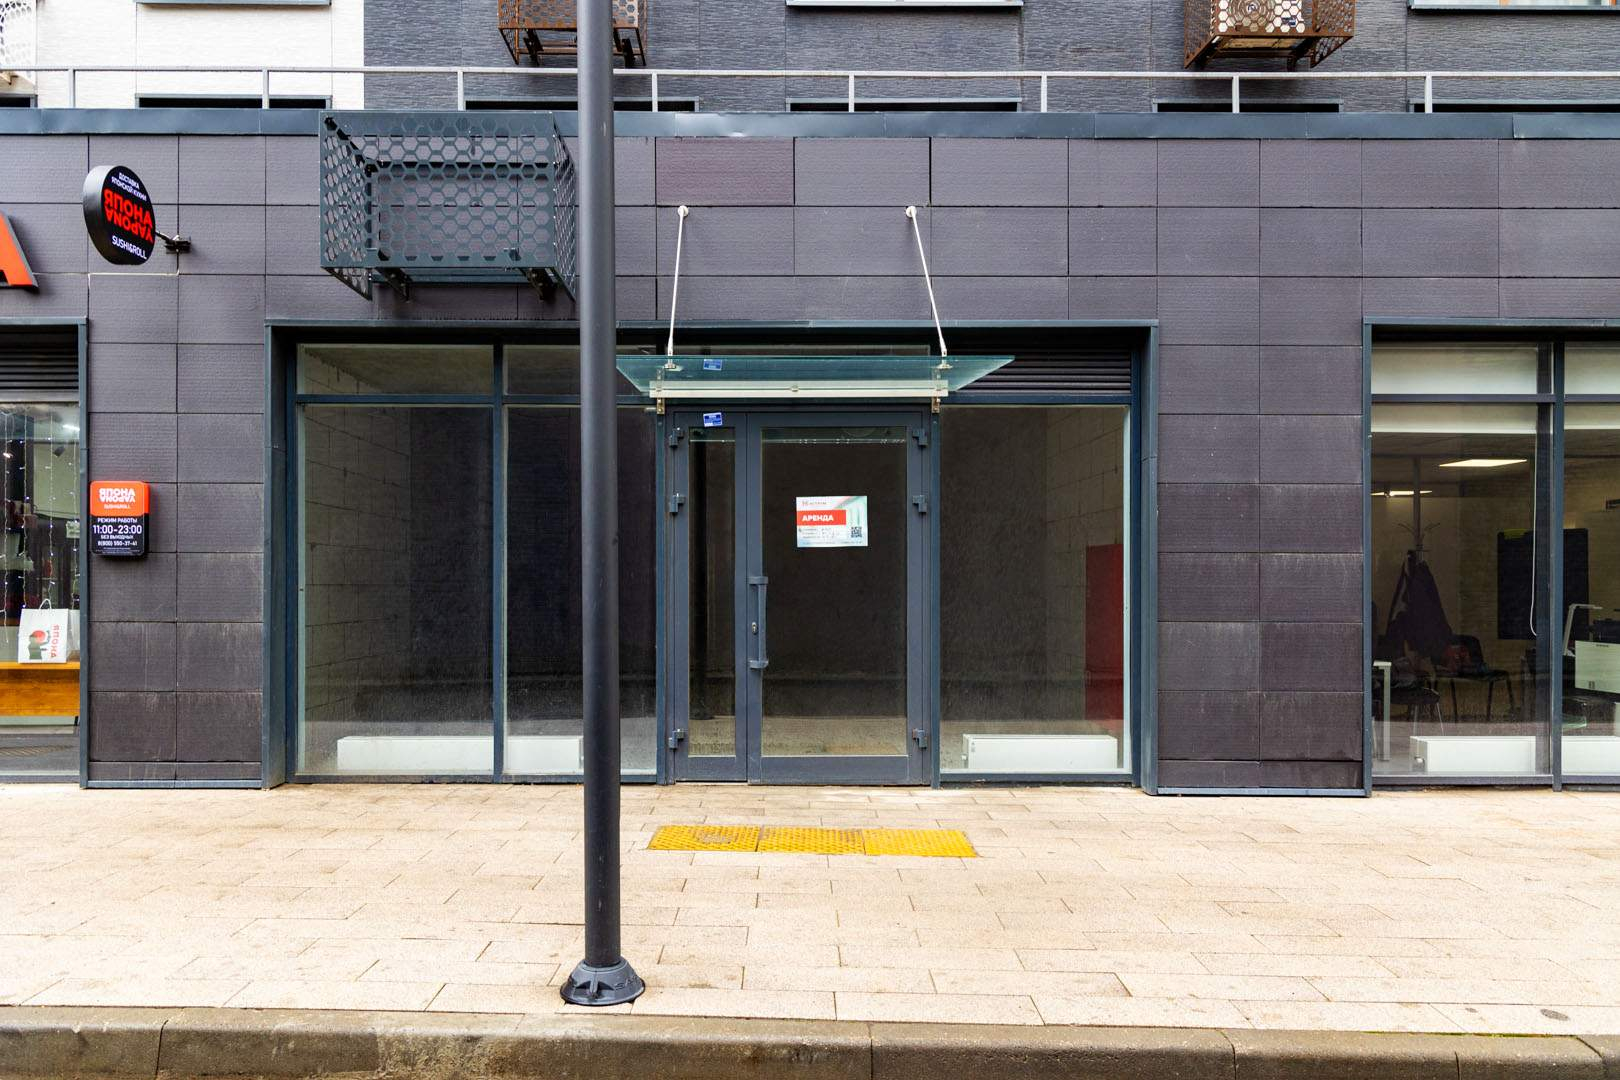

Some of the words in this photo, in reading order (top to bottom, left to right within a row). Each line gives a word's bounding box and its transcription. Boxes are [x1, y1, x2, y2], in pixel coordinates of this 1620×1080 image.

[103, 188, 153, 229] ЯПОНА
[112, 235, 147, 260] SUSHI&ROLL
[99, 488, 136, 497] ЯПОНА
